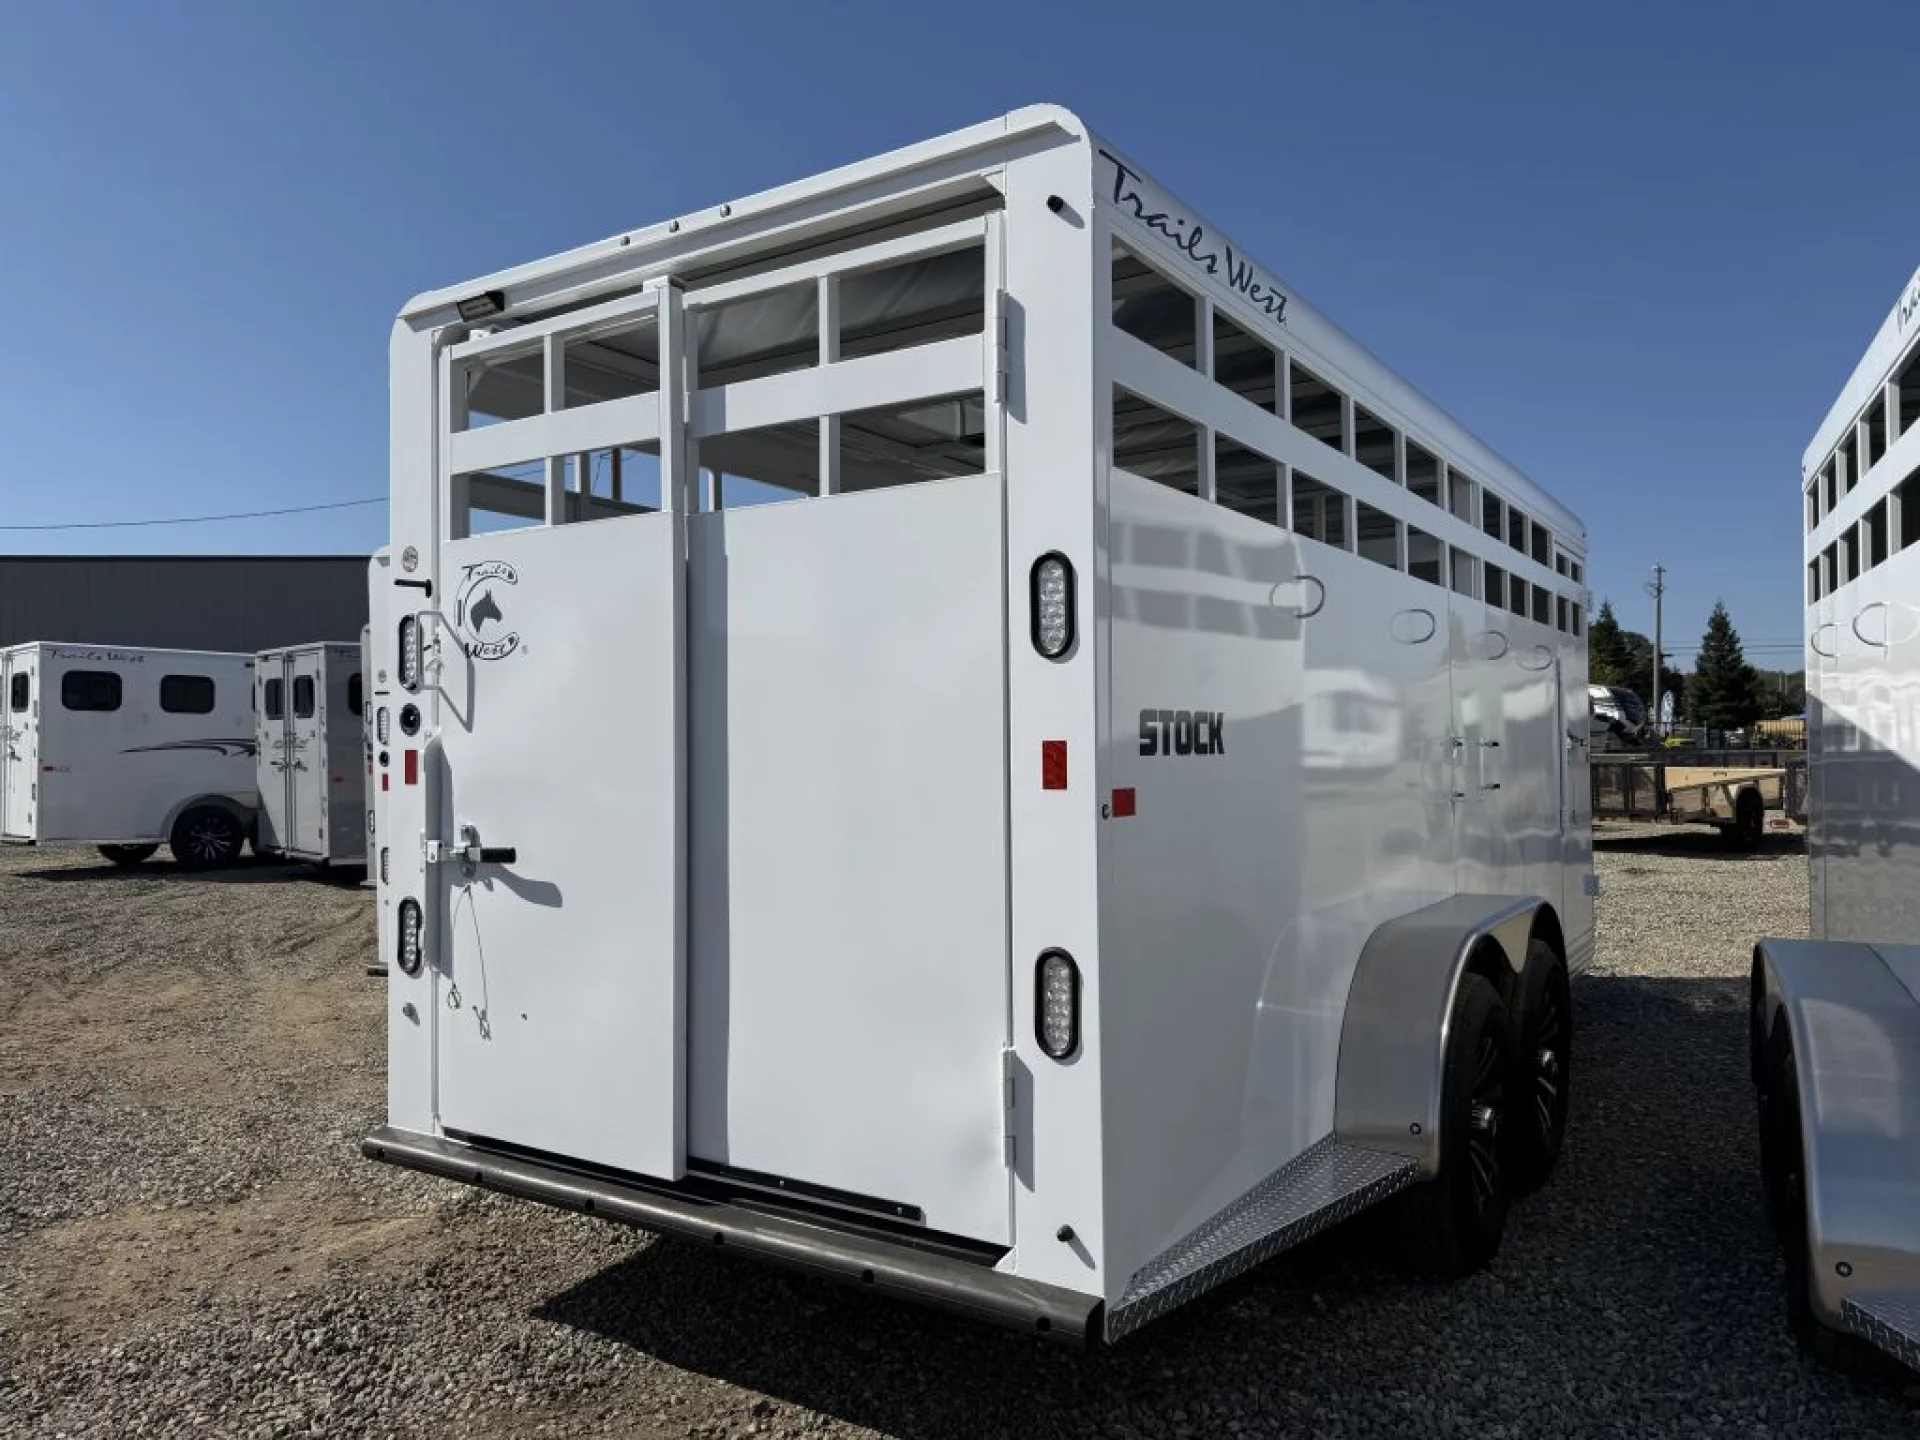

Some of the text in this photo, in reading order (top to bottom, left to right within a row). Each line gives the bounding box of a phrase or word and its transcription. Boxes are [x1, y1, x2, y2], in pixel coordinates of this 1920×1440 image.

[1098, 149, 1287, 323] Trails West
[464, 642, 507, 659] West
[1139, 708, 1226, 757] STOCK
